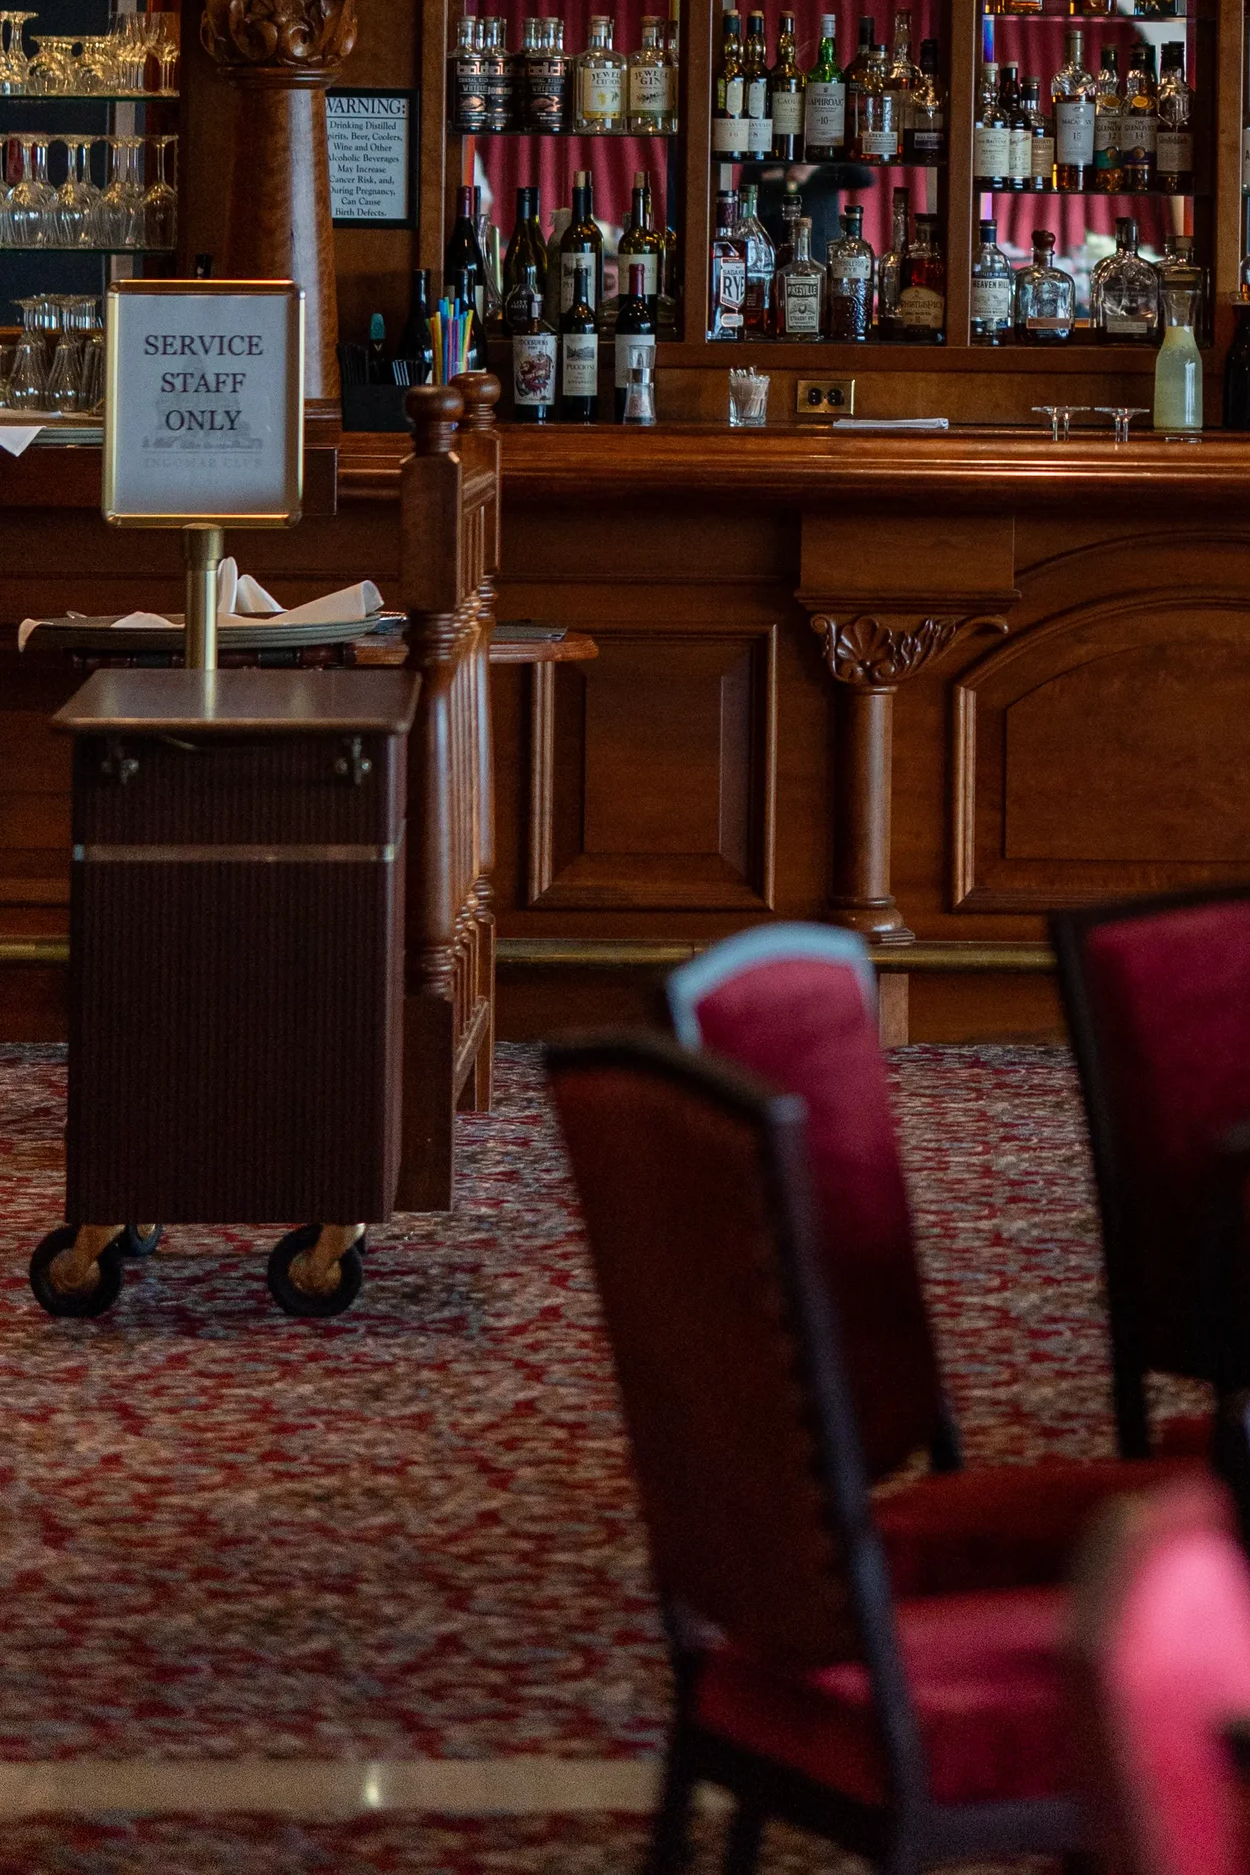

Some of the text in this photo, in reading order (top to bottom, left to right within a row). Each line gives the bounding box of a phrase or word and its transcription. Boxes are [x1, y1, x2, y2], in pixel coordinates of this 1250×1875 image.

[640, 77, 662, 85] GIN
[462, 84, 488, 92] WHISKE
[820, 116, 829, 125] 10
[330, 121, 397, 130] Drinking Distilled
[372, 133, 403, 142] Coolers,
[1072, 132, 1081, 140] 15
[1134, 132, 1143, 140] 14
[334, 142, 392, 152] Wine and Other
[363, 154, 399, 163] Beverages
[337, 165, 386, 174] May Increase
[355, 187, 396, 196] Pregnancy,
[341, 197, 381, 206] Can Cause
[335, 208, 387, 217] Birth Defects.
[722, 276, 744, 301] RYE
[973, 280, 996, 289] HEAVEN
[144, 334, 264, 356] SERVICE
[160, 372, 247, 394] STAFF
[164, 409, 242, 431] ONLY
